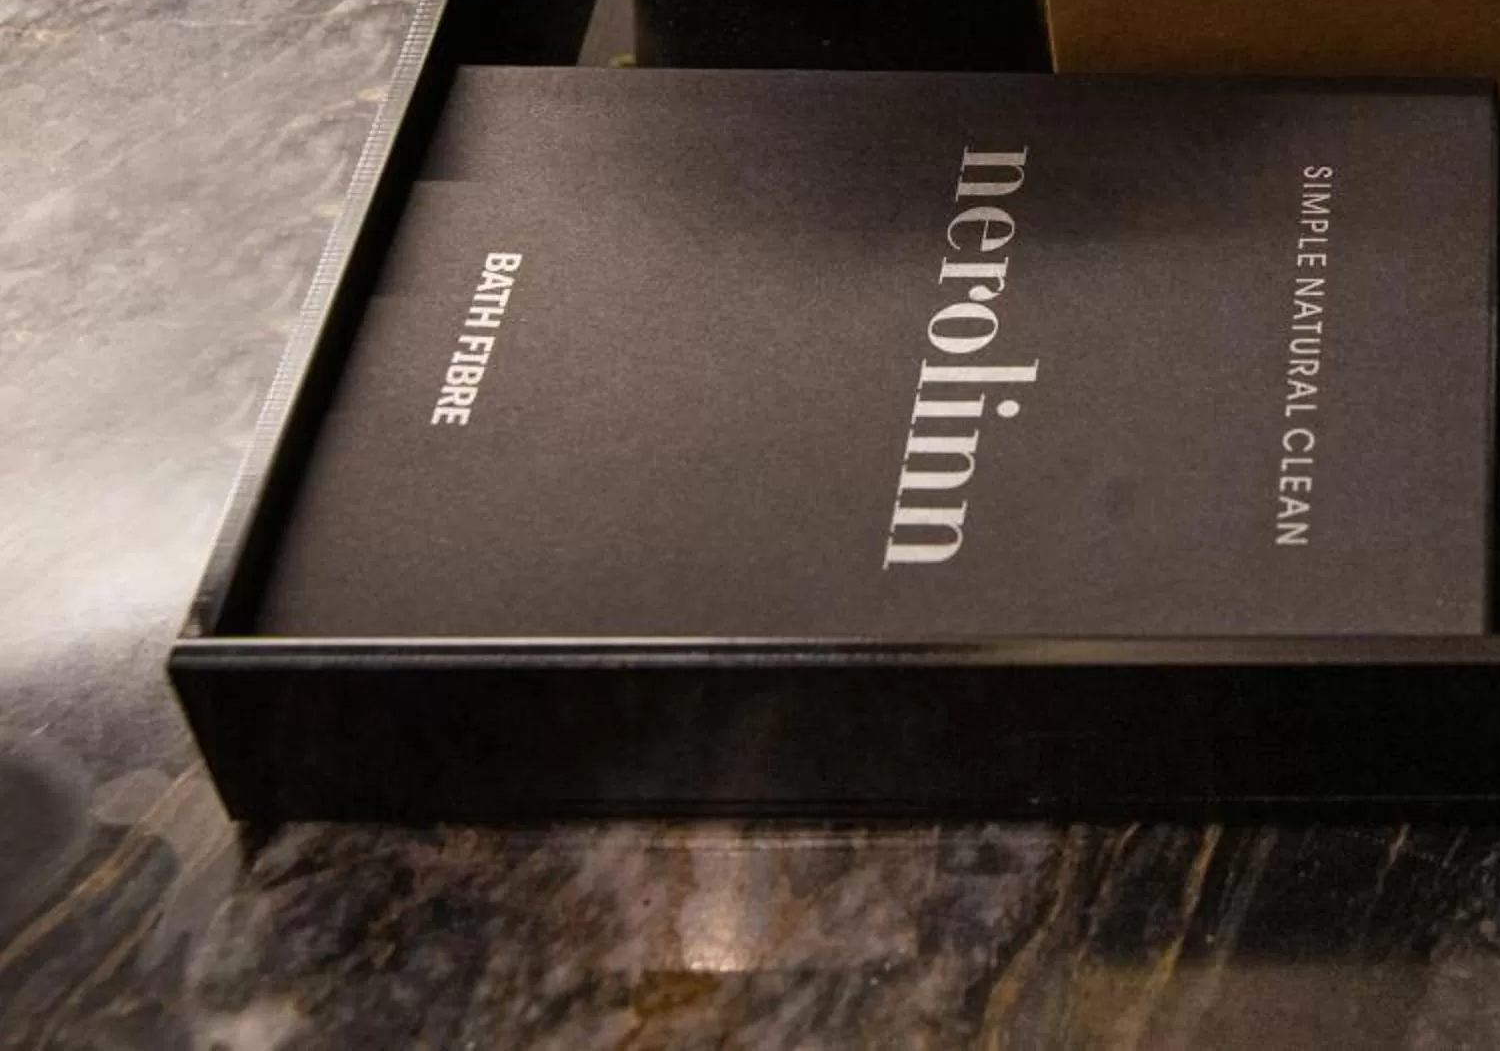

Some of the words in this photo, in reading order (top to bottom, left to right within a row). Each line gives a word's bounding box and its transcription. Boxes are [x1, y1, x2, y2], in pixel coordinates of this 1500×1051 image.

[1296, 165, 1334, 269] SIMPLE
[463, 251, 524, 329] BATH
[430, 333, 497, 427] FIBRE
[882, 146, 1040, 571] nerolinn
[1284, 277, 1327, 417] NATURAL
[1274, 428, 1317, 546] CLEAN
